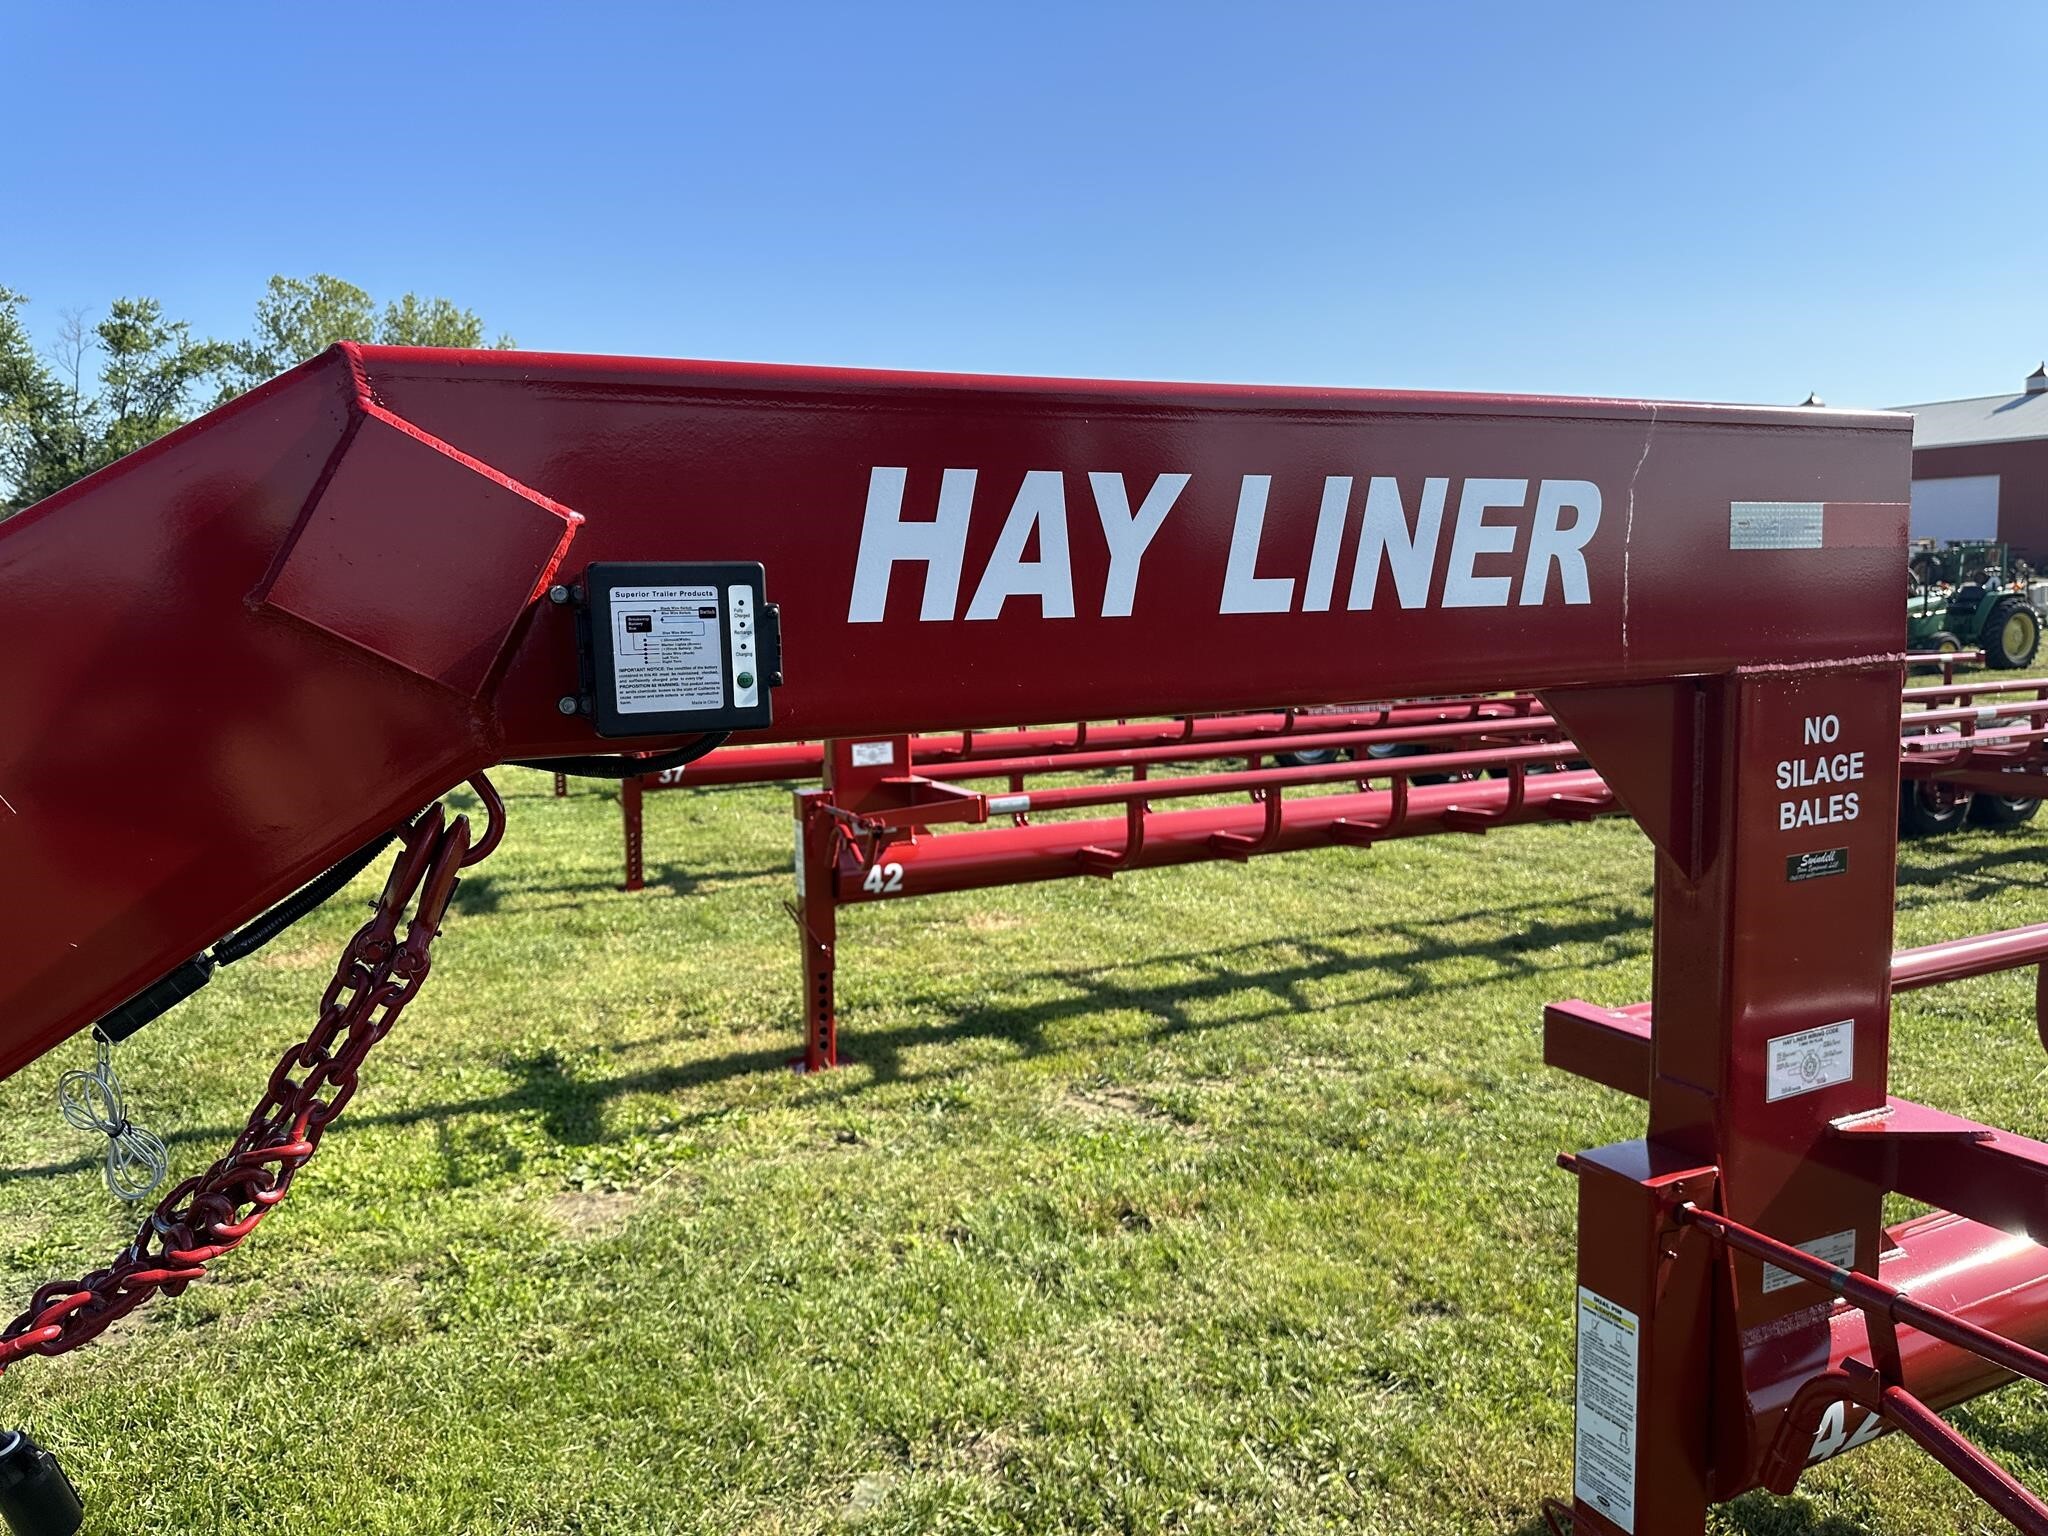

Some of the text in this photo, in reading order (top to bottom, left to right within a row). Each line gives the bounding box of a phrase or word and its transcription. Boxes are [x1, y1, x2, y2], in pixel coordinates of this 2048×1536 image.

[848, 466, 1602, 623] HAY LINER
[1804, 714, 1840, 745] NO
[1776, 751, 1864, 790] SILAGE
[1780, 792, 1859, 830] BALES
[1800, 850, 1836, 866] Swindell
[862, 862, 904, 893] 42
[1793, 1035, 1807, 1043] LINER
[1808, 1400, 1882, 1460] 42
